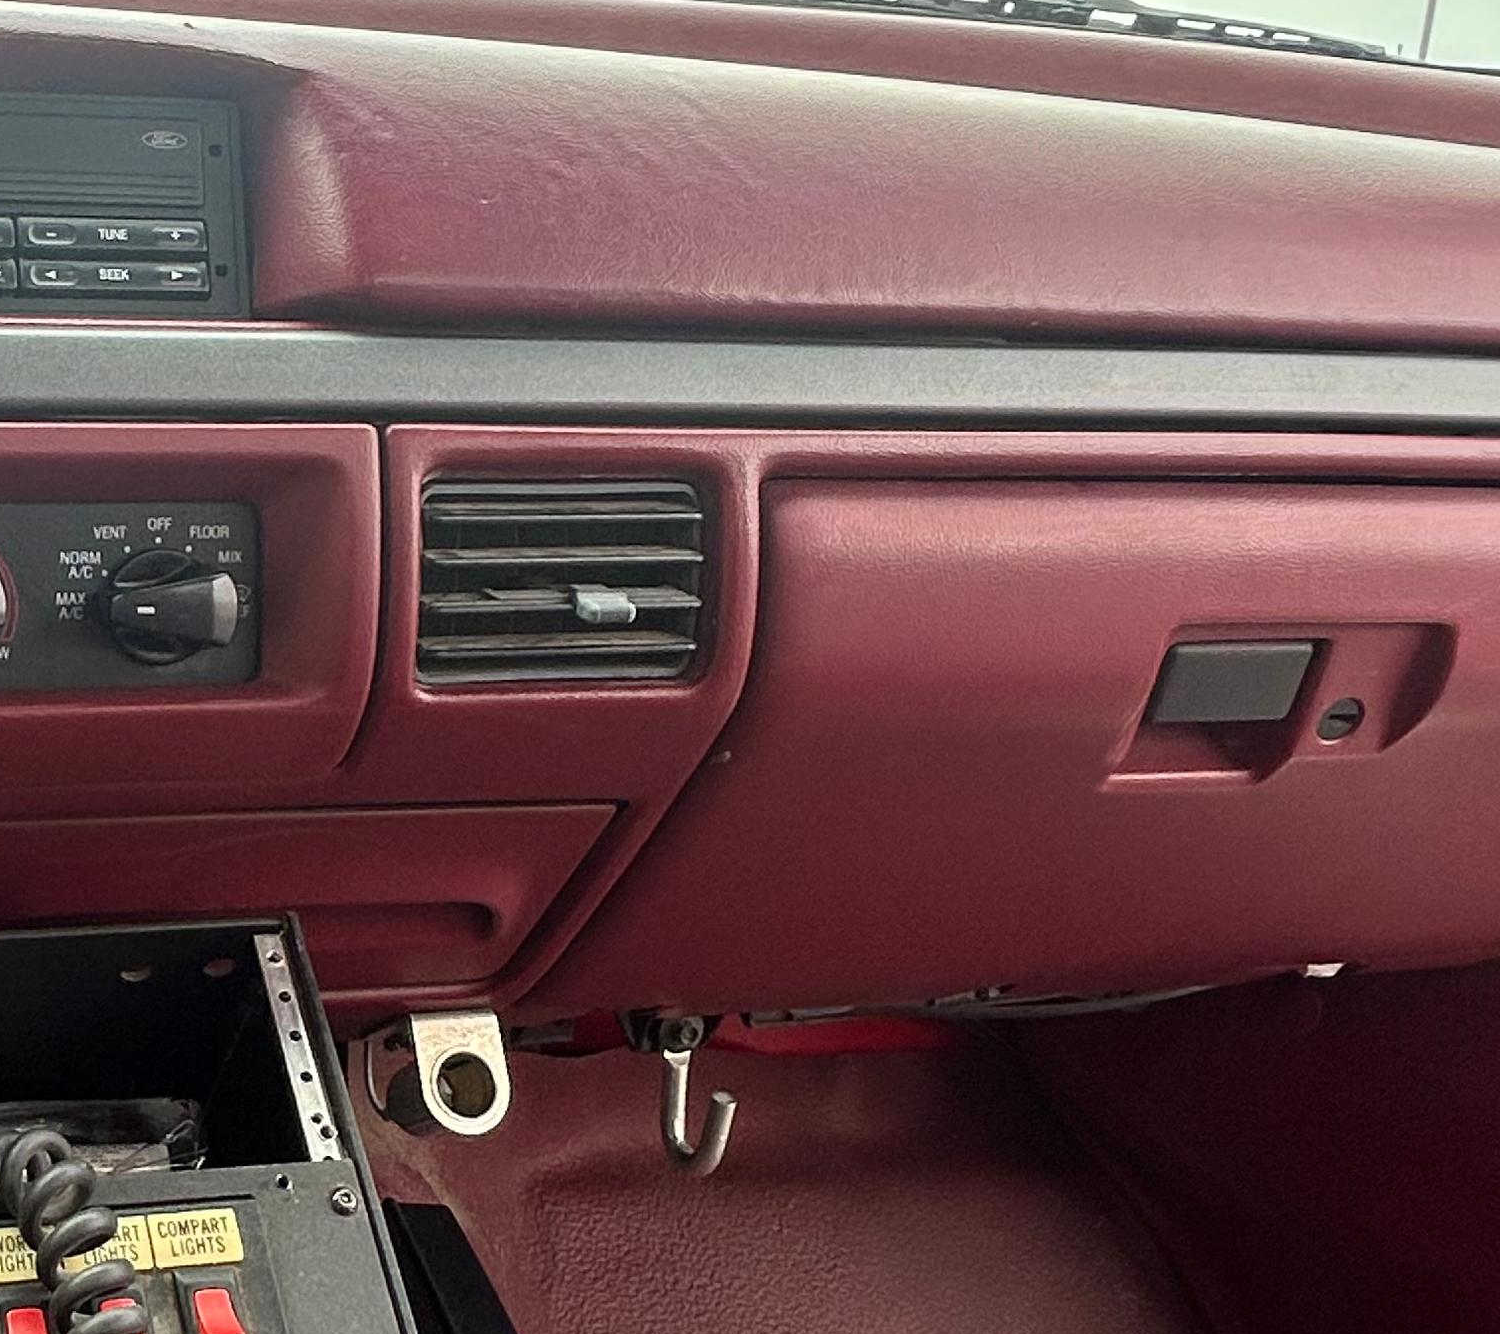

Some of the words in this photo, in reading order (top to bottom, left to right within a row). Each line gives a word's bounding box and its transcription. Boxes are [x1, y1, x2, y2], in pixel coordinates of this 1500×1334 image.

[97, 227, 129, 240] TUNE
[98, 268, 131, 281] SEEK
[93, 524, 128, 540] VENT
[147, 517, 173, 532] OFF
[189, 524, 231, 539] FLOOR
[59, 550, 102, 565] NORM
[217, 550, 243, 564] MIX
[67, 565, 93, 580] A/C
[55, 591, 87, 607] MAX
[58, 605, 85, 621] A/C
[157, 1216, 228, 1239] COMPART
[169, 1235, 226, 1257] LIGHTS
